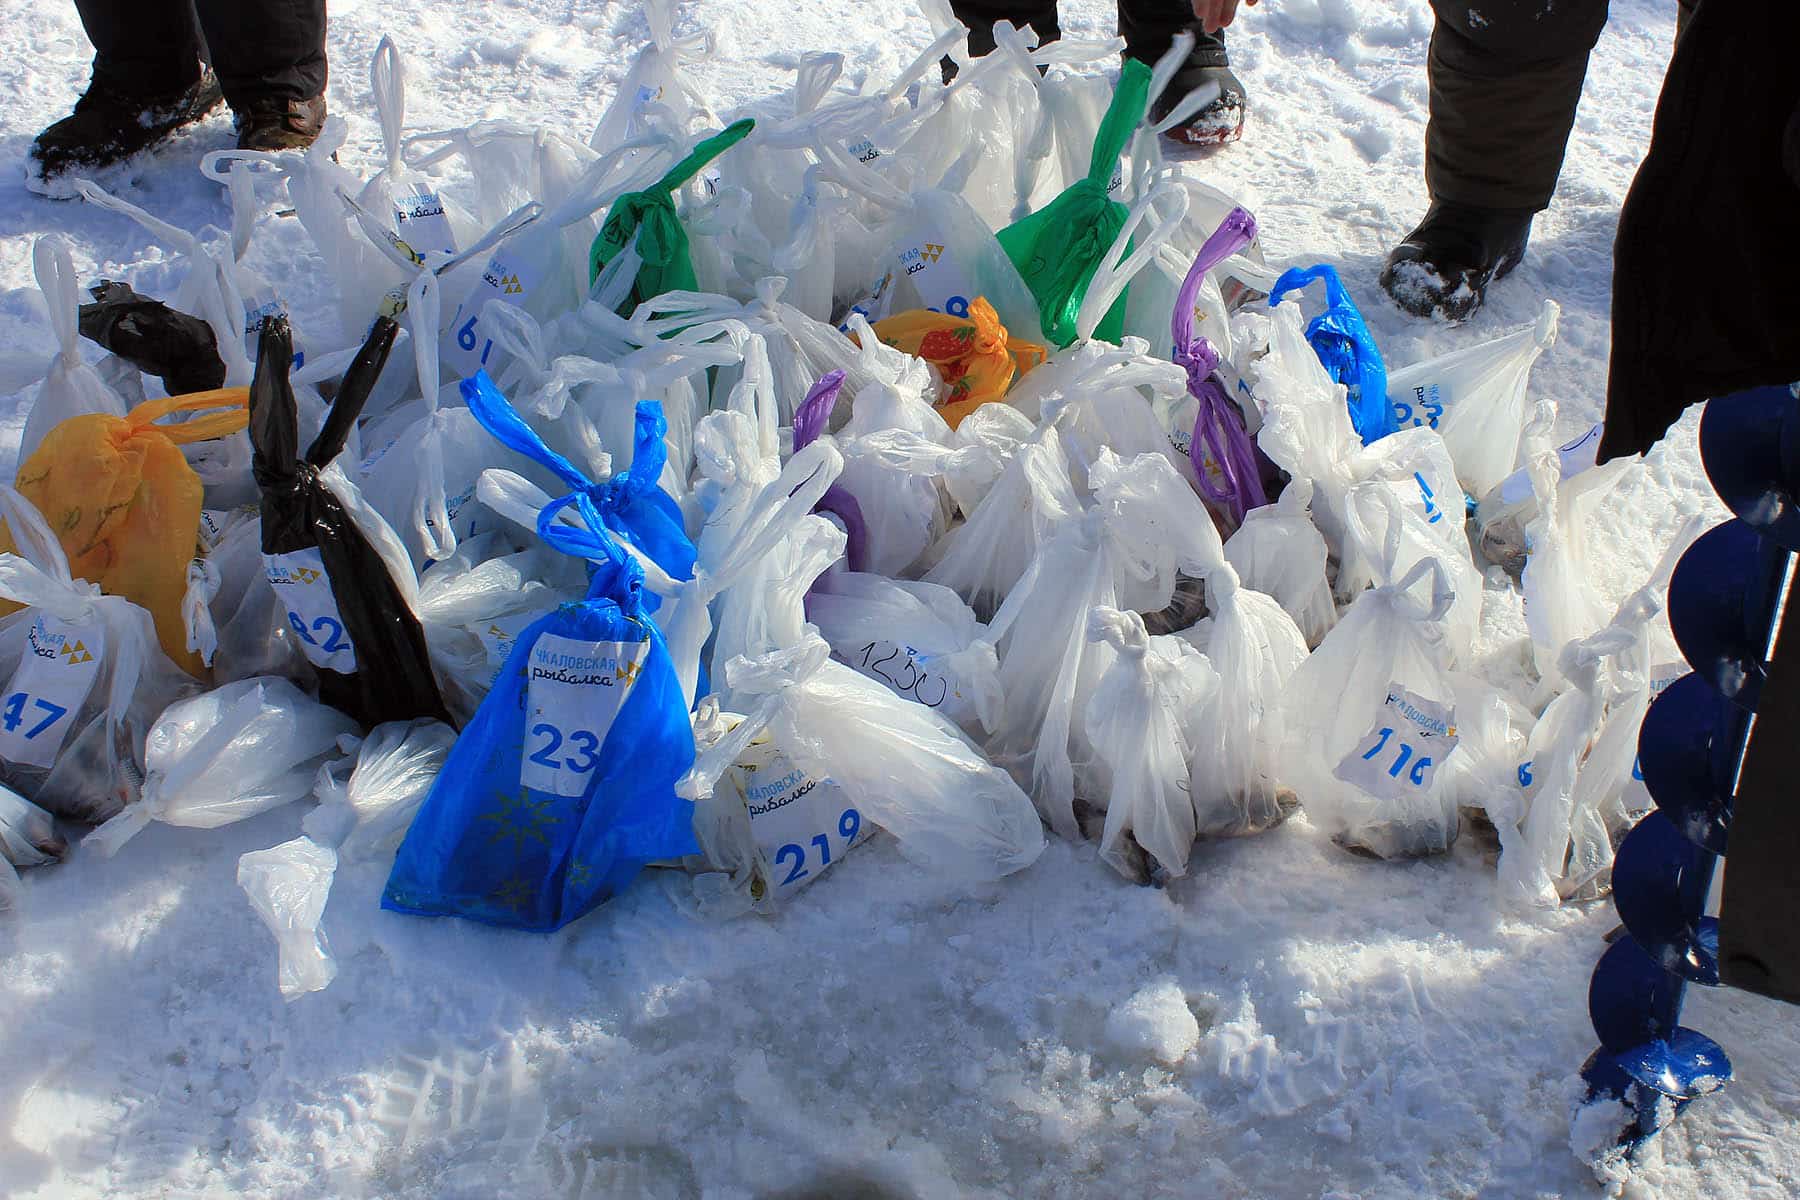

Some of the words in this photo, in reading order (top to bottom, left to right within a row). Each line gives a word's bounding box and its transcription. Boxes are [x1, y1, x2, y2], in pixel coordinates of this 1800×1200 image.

[533, 666, 613, 687] рыбалка
[536, 648, 616, 671] ЧКАЛОВСКАЯ
[4, 692, 67, 740] 47
[529, 723, 600, 773] 23
[749, 780, 816, 820] рыбалка
[775, 808, 860, 887] 219
